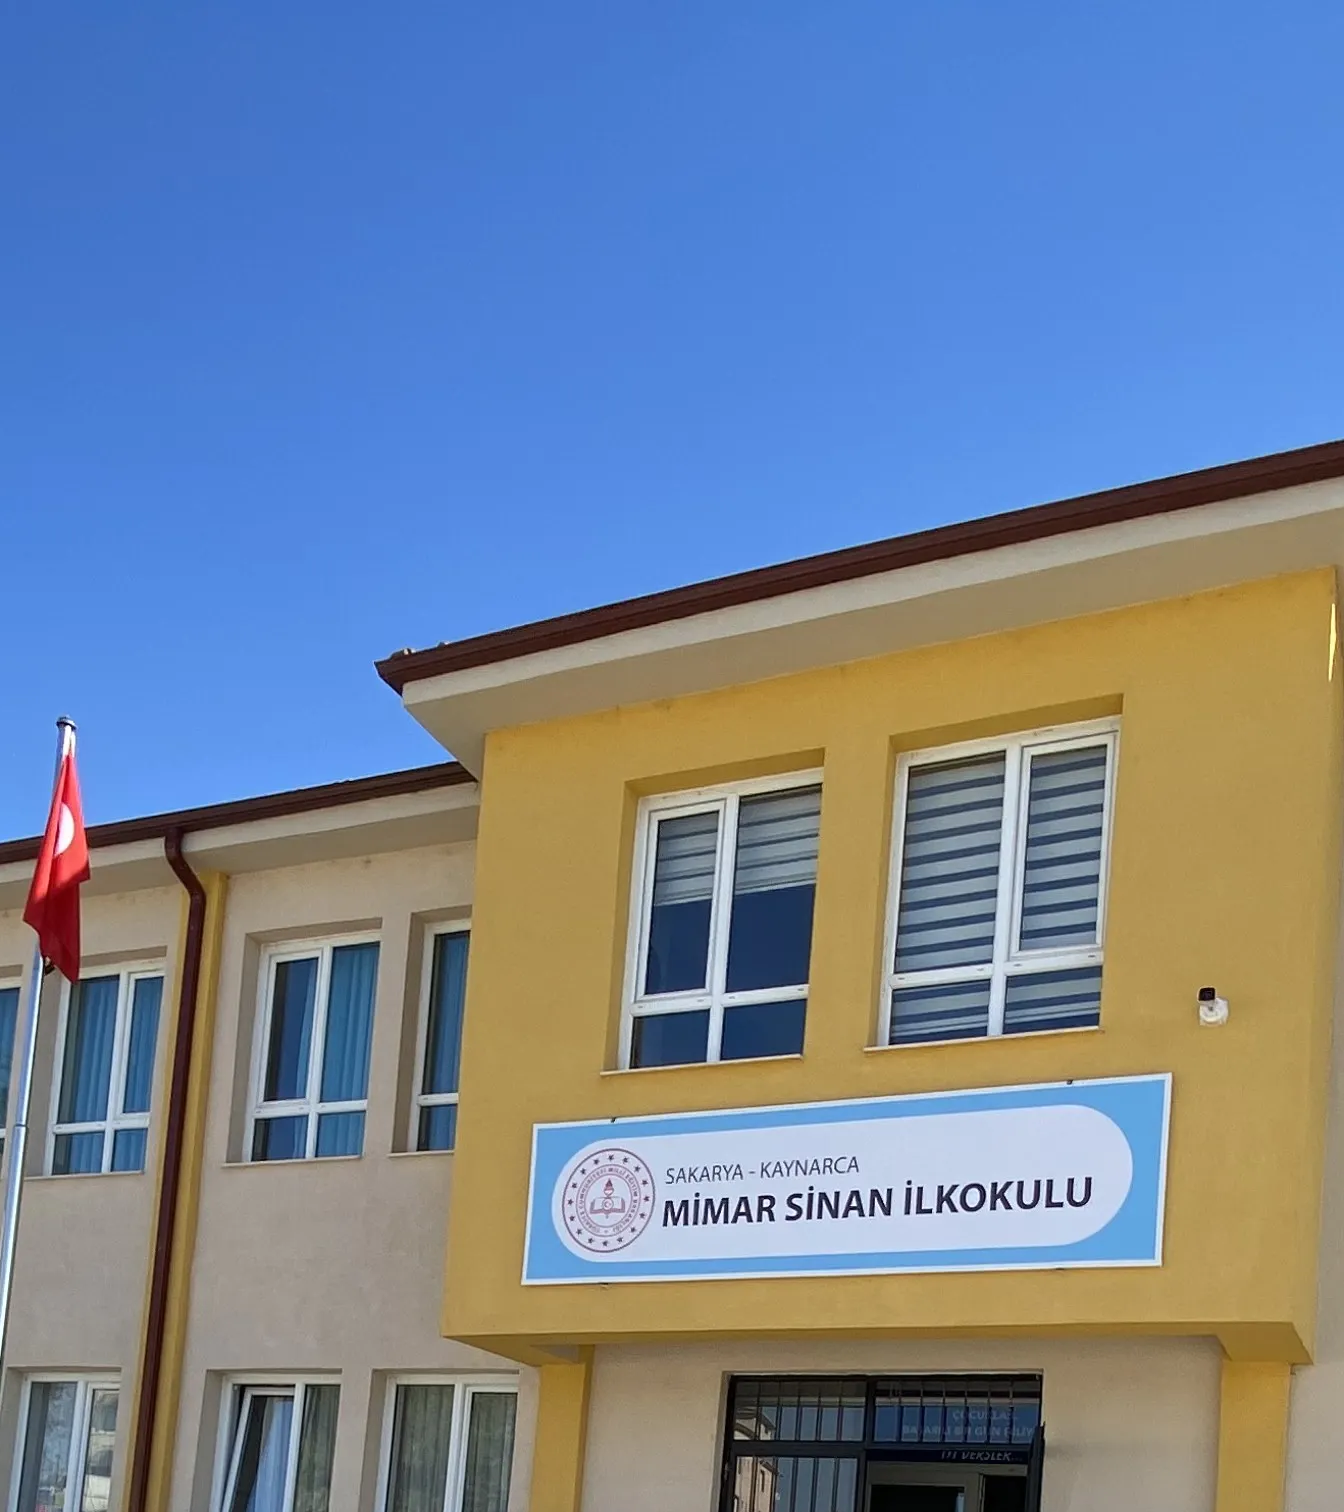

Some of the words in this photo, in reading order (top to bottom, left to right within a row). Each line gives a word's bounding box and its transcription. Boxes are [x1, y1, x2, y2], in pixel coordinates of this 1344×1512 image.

[665, 1163, 744, 1185] SAKARYA
[760, 1156, 860, 1179] KAYNARCA
[662, 1192, 776, 1228] MİMAR
[784, 1185, 893, 1222] SİNAN
[903, 1176, 1093, 1216] İLKOKULU
